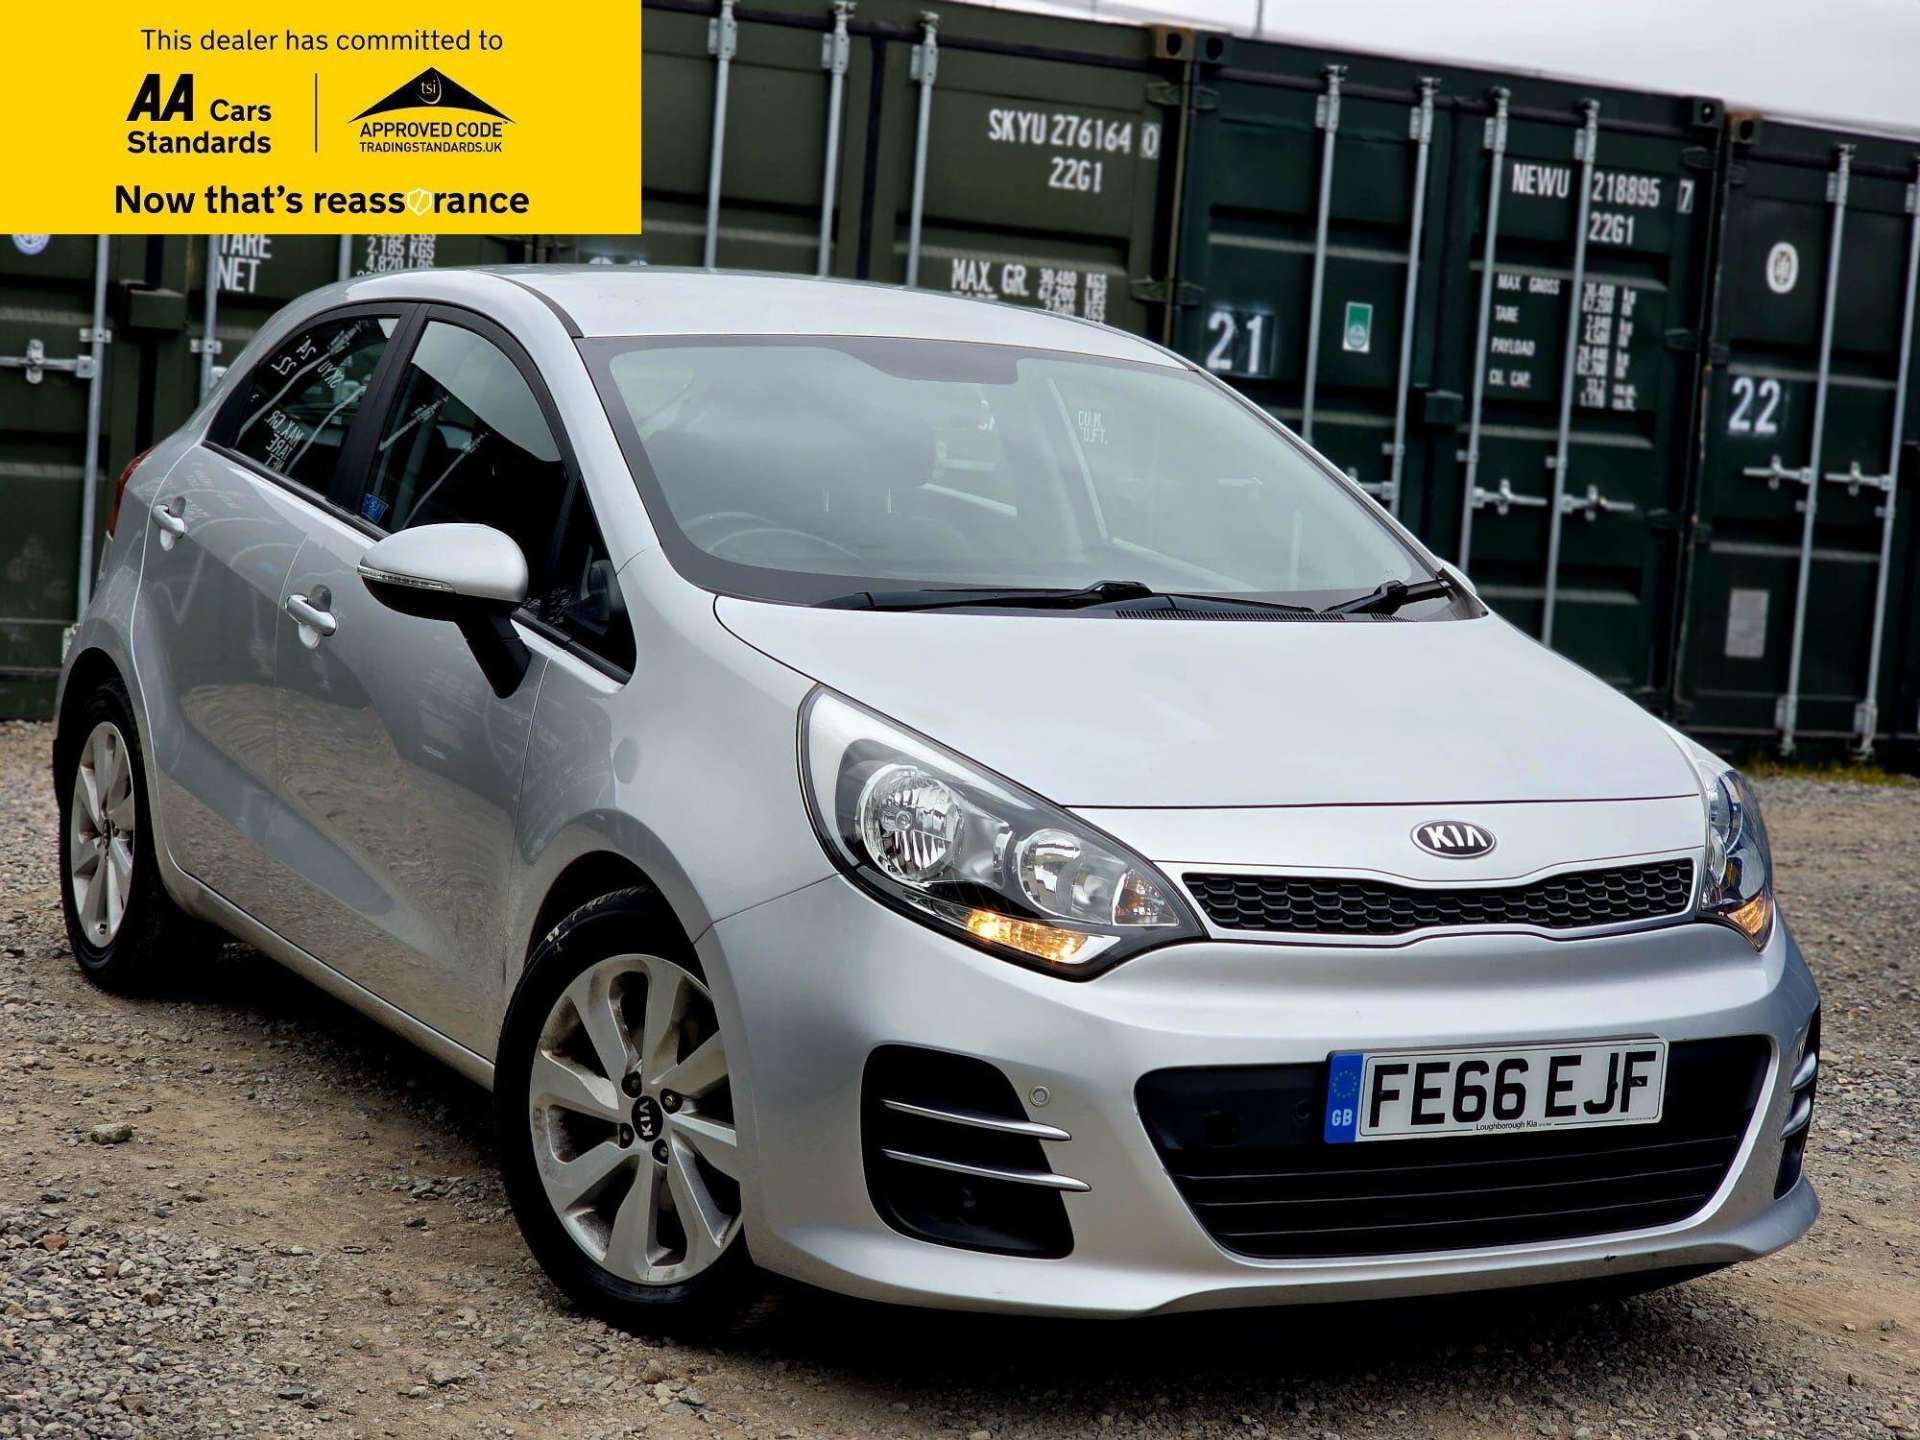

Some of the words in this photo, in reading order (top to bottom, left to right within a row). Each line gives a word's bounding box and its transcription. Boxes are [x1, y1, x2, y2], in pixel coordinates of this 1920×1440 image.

[988, 108, 1047, 144] SKYU
[1050, 113, 1133, 154] 276164
[1048, 156, 1102, 193] 22G1
[1512, 163, 1571, 199] NEWU
[1592, 172, 1662, 208] 218895
[217, 234, 273, 260] TARE
[1588, 211, 1636, 247] 22G1
[408, 241, 436, 260] KGS
[216, 256, 261, 293] NET
[1497, 273, 1521, 291] MAX
[1529, 275, 1561, 295] GROSS
[1495, 304, 1519, 322] TARE
[1206, 310, 1264, 375] 21
[1491, 336, 1535, 357] PAYLOAD
[1728, 377, 1781, 433] 22
[1424, 825, 1488, 849] KIA
[1368, 1058, 1530, 1128] FE66
[1544, 1050, 1657, 1119] EJF
[639, 1100, 654, 1137] KIA
[1331, 1108, 1353, 1127] GB
[1475, 1120, 1525, 1132] Loughborough
[1526, 1119, 1538, 1129] Kia
